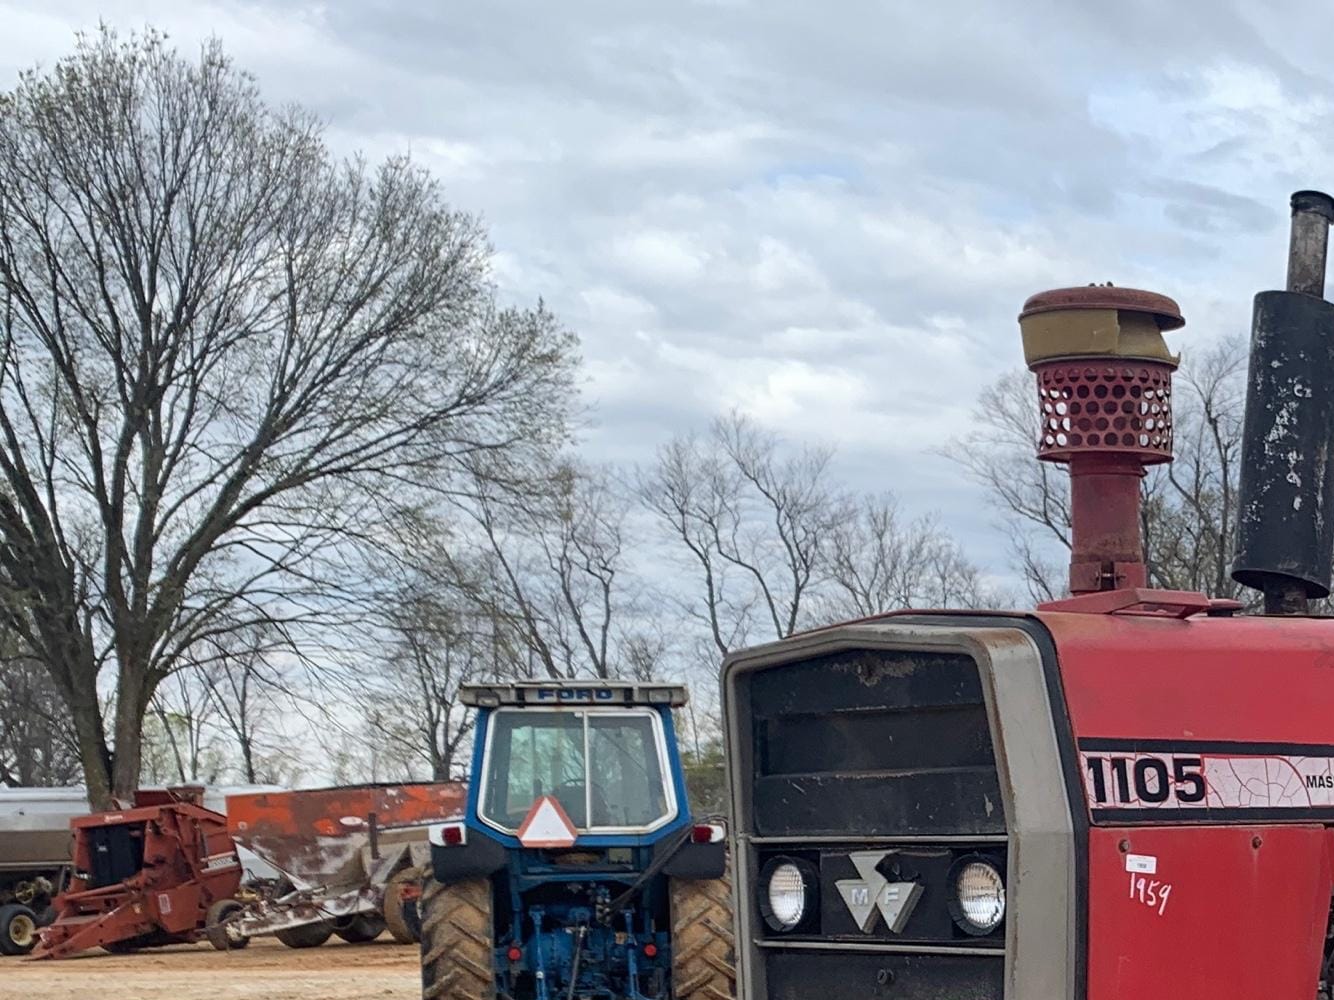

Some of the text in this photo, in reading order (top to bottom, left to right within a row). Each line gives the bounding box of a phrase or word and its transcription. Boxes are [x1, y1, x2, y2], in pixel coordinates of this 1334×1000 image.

[538, 688, 613, 700] FORD
[1087, 757, 1206, 803] 1105
[1130, 873, 1172, 916] 1959
